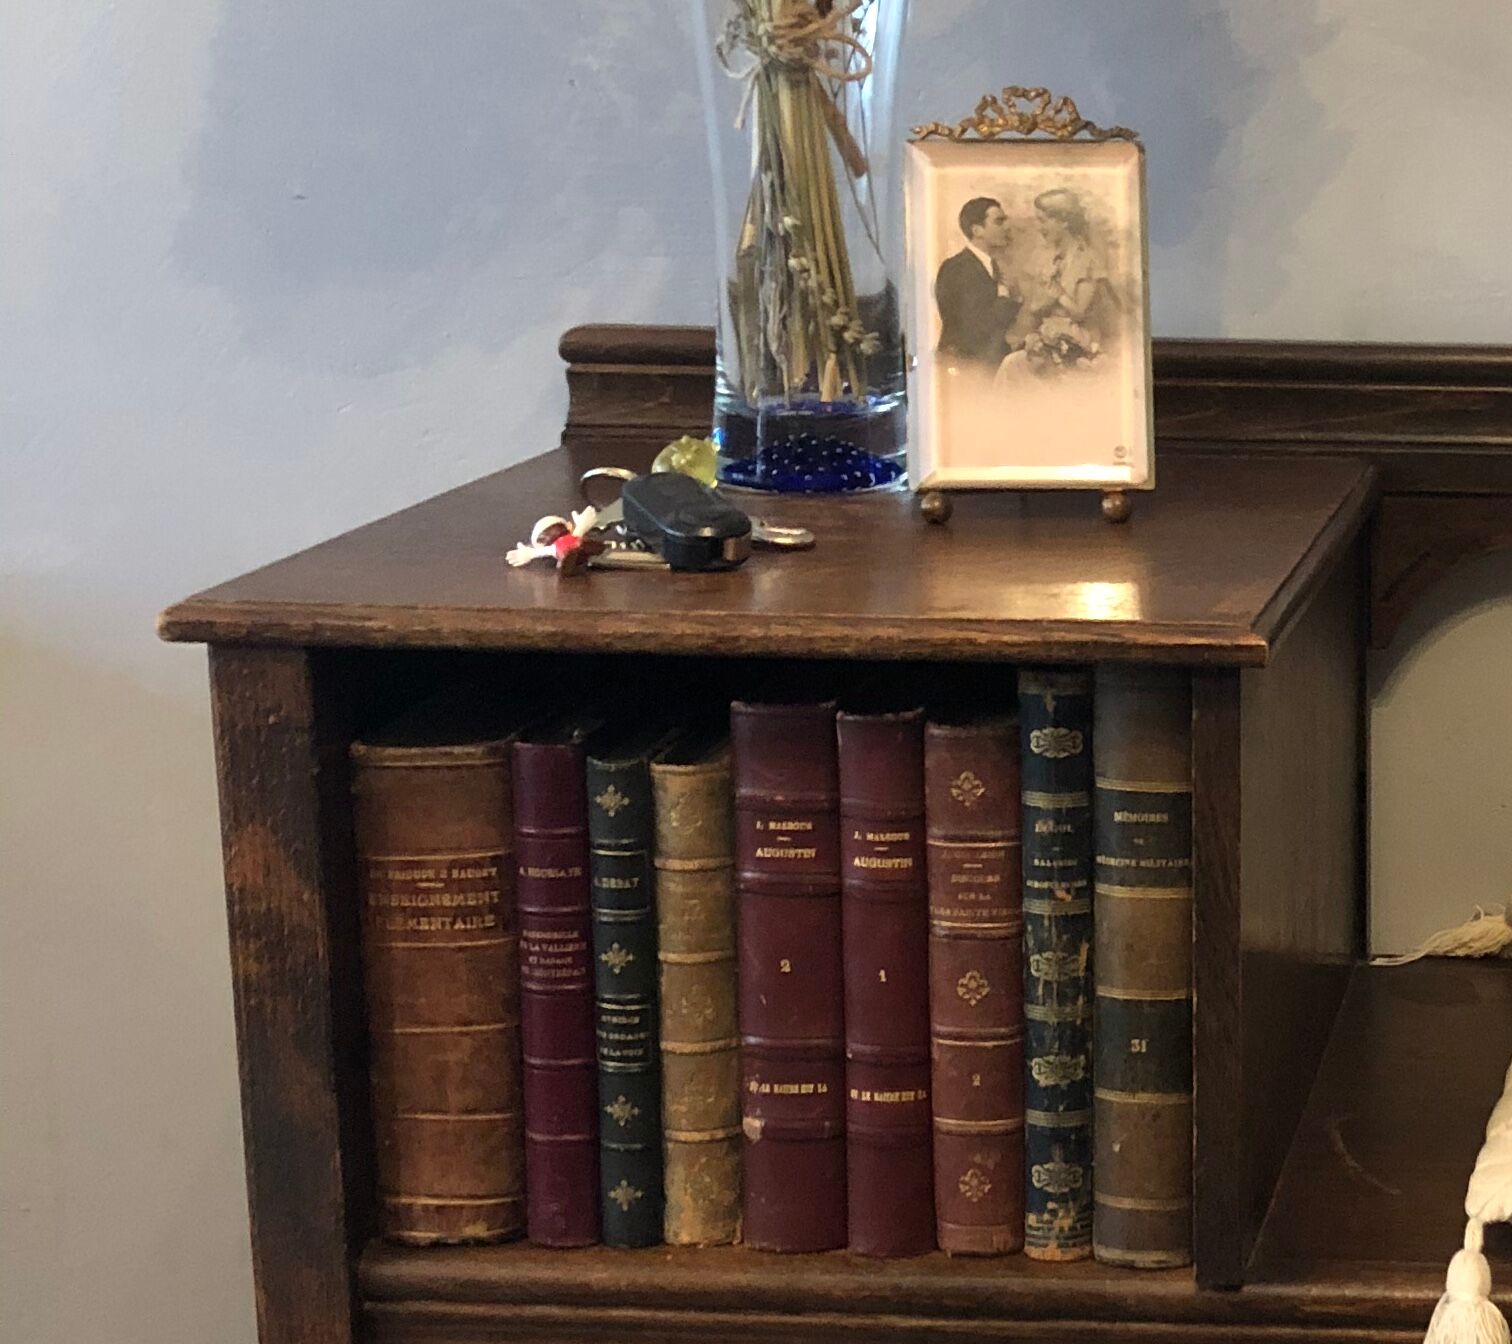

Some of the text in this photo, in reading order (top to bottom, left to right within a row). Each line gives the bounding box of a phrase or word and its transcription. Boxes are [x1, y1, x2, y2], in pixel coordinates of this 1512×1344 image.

[755, 847, 817, 859] AUGUSTIN
[853, 855, 913, 869] AUGUSTIN
[779, 958, 792, 974] 2
[878, 969, 888, 983] 1
